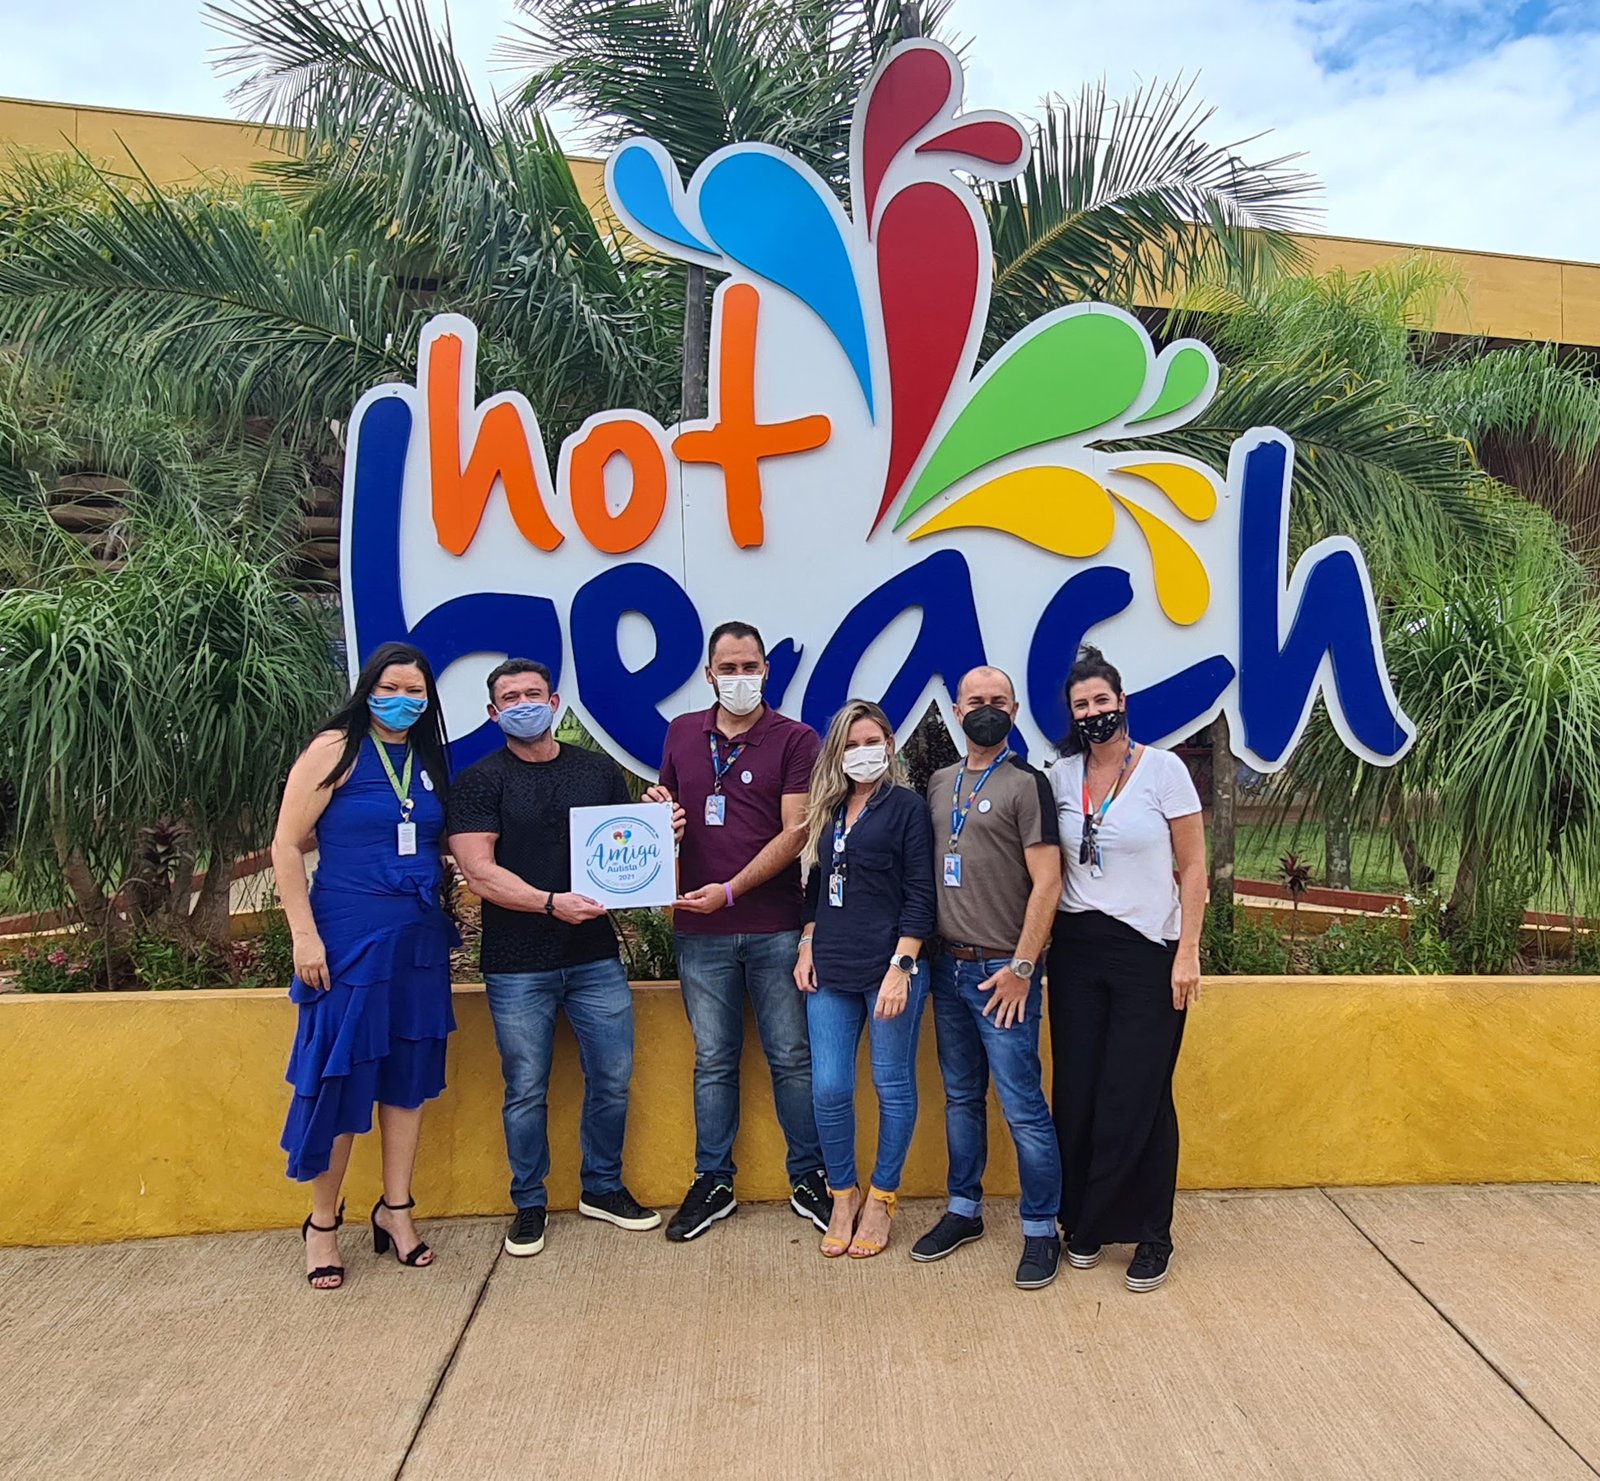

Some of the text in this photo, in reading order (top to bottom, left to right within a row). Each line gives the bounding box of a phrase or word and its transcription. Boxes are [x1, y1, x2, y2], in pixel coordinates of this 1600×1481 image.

[428, 283, 831, 556] hot
[350, 396, 1409, 775] beach
[586, 843, 660, 870] Amiga
[607, 864, 638, 873] Autista
